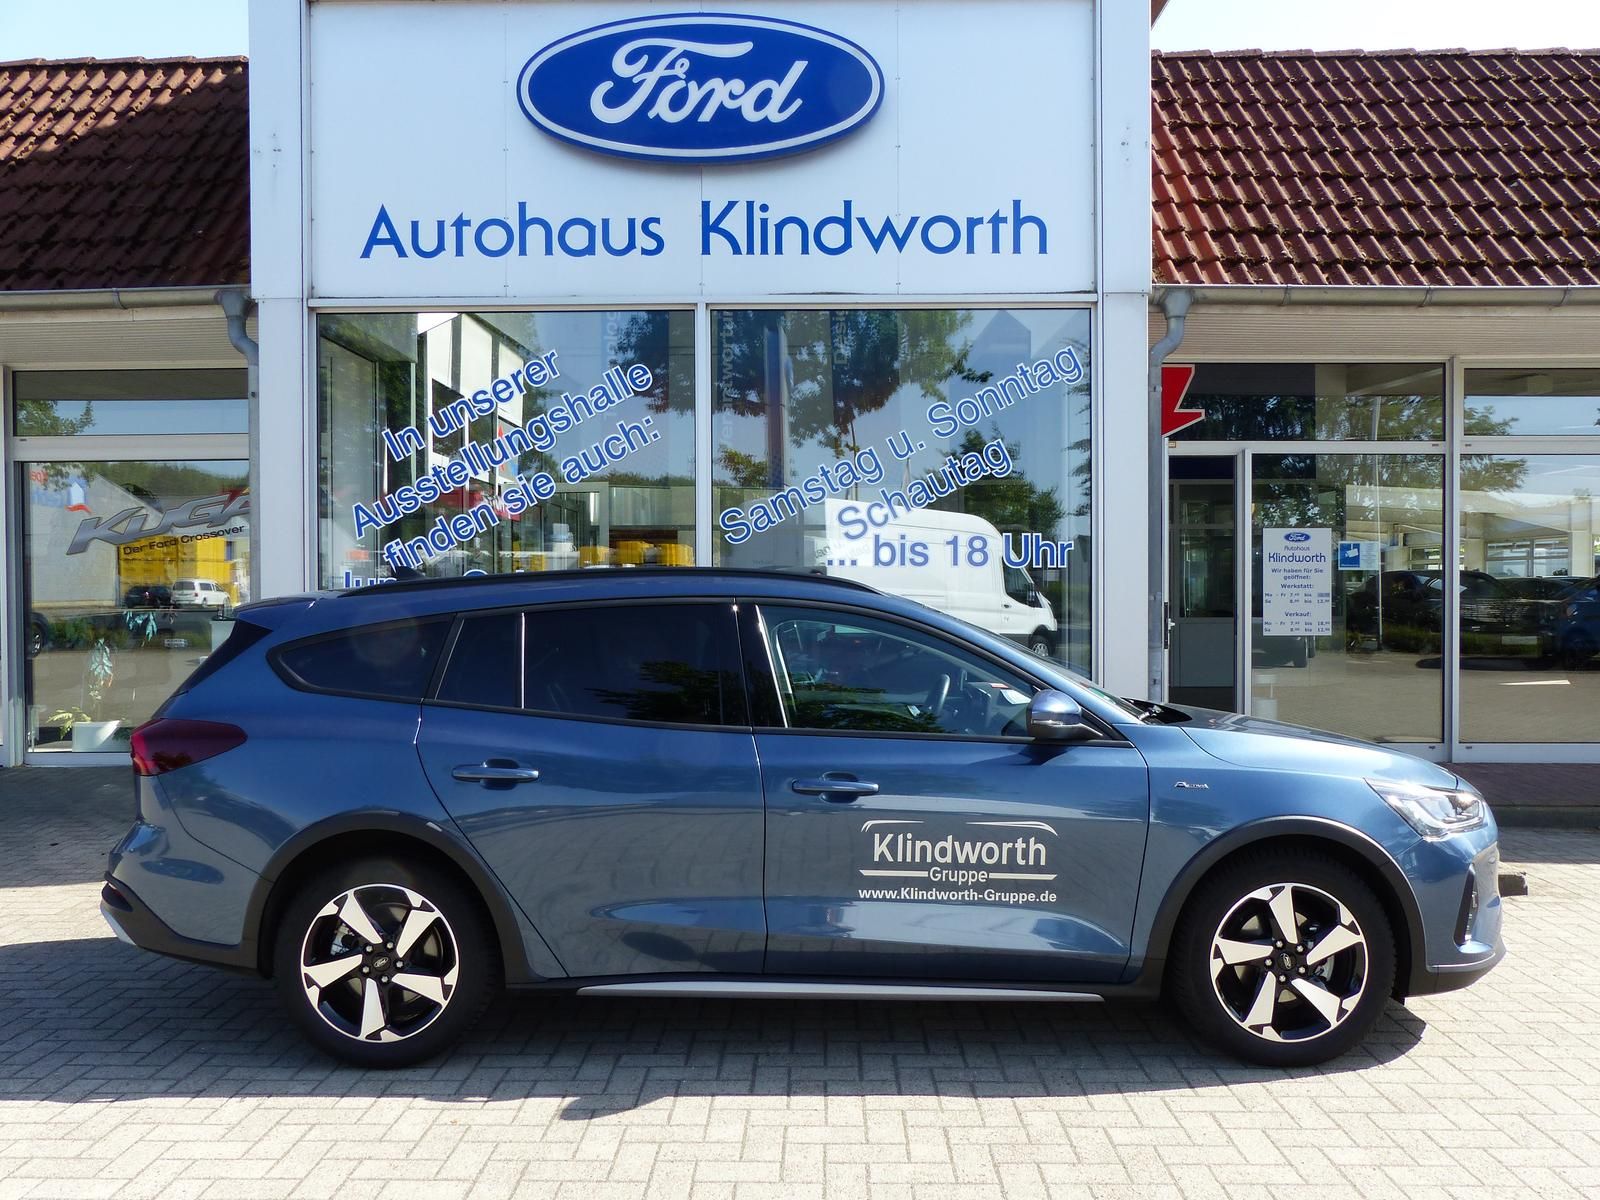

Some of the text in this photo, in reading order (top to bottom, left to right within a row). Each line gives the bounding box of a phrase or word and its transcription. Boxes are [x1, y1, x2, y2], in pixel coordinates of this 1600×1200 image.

[590, 38, 808, 123] Ford
[360, 199, 1049, 259] Autohaus Klindworth
[382, 349, 561, 463] In unserer
[352, 362, 654, 541] Ausstellungshalle
[719, 345, 1084, 546] Samstag u. Sonntag
[382, 415, 662, 571] finden sie auch:
[837, 438, 1013, 541] Schautag
[123, 544, 149, 555] Der
[180, 525, 245, 544] Crossover
[873, 534, 929, 567] bis
[945, 535, 989, 567] 18
[1002, 531, 1075, 568] Uhr
[1268, 552, 1326, 563] Klindworth
[873, 832, 1047, 866] Klindworth
[929, 866, 988, 885] Gruppe
[858, 887, 1057, 904] www.Klindworth-Gruppe.de
